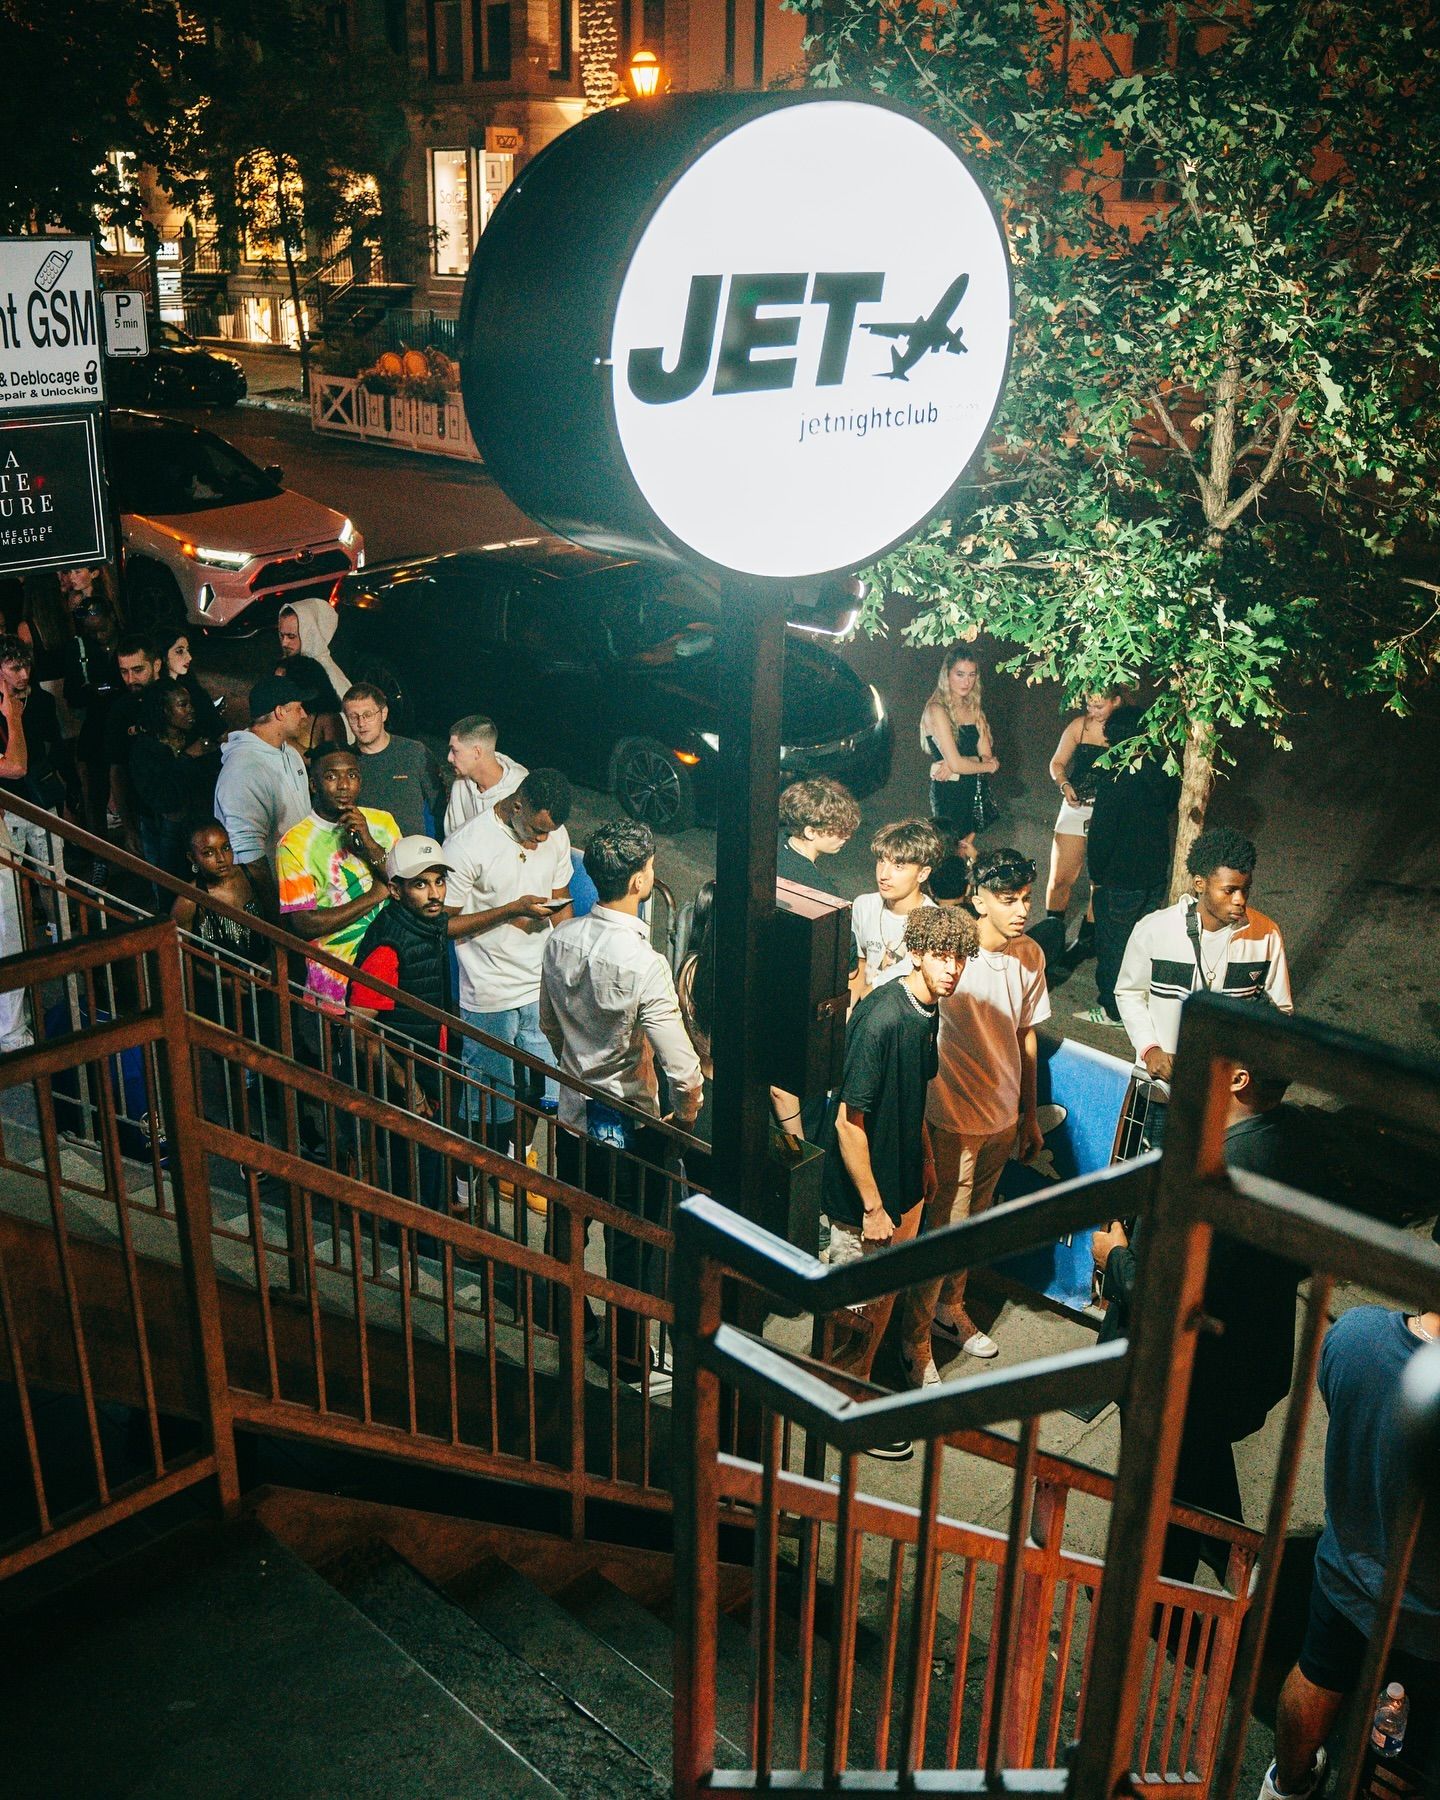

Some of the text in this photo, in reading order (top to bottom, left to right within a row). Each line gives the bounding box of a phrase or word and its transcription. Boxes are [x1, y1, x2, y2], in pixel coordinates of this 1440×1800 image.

[115, 294, 131, 317] P
[27, 289, 97, 349] GSM
[114, 318, 138, 329] 5 min
[627, 272, 886, 405] JET
[10, 370, 80, 386] Deblocage
[30, 389, 38, 398] &
[41, 385, 98, 397] Unlocking
[799, 401, 938, 442] jetnightclub
[5, 450, 20, 469] A
[0, 473, 30, 494] TE
[0, 494, 53, 517] URE
[2, 534, 45, 546] MESURE
[23, 528, 35, 536] ET
[40, 525, 53, 534] DE
